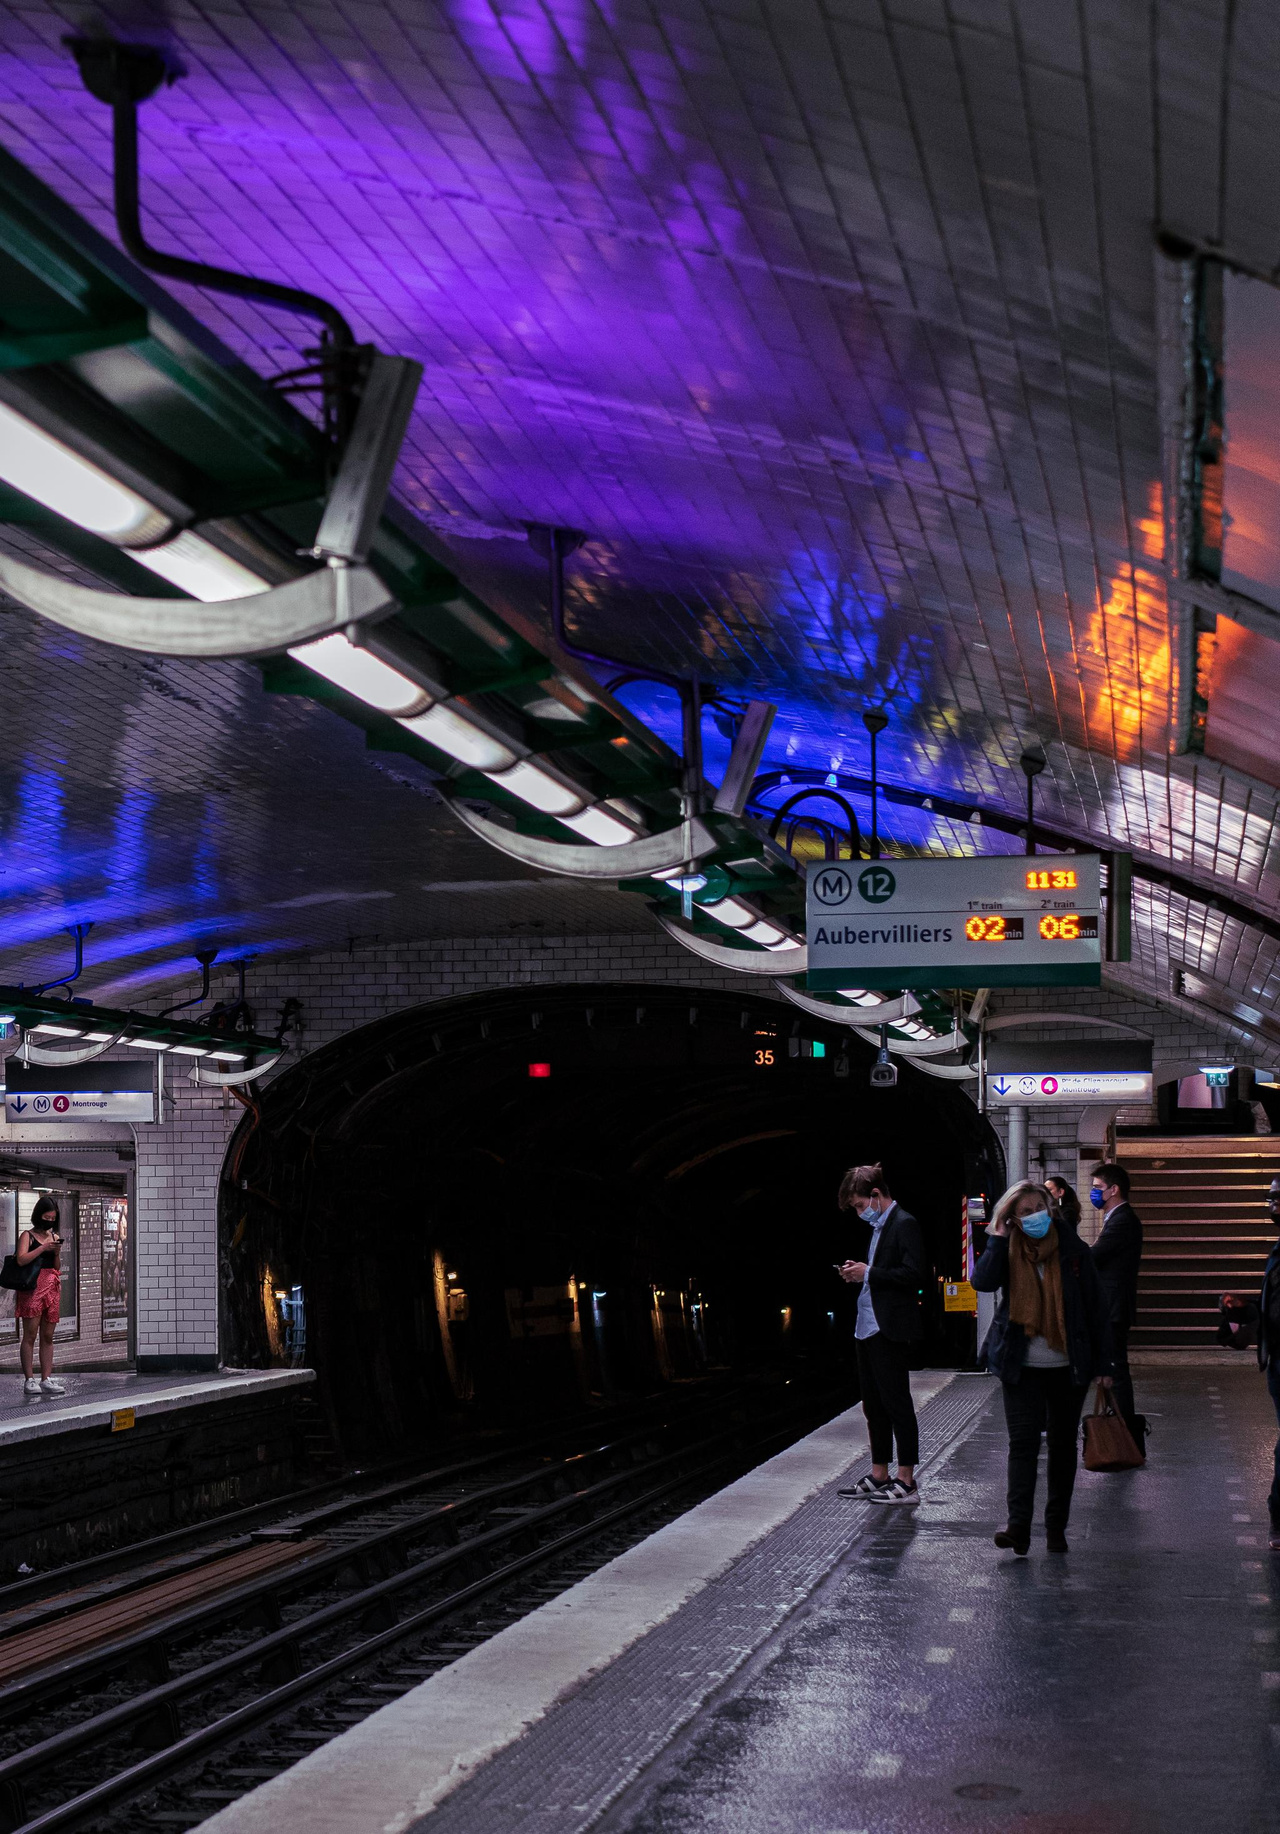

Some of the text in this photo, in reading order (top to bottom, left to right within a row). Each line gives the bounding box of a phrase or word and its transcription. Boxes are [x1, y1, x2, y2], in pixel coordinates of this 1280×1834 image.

[823, 874, 891, 897] M 12
[981, 902, 1003, 910] train
[1053, 900, 1075, 908] train
[814, 924, 952, 945] Aubervilliers
[966, 916, 1006, 941] 02
[1039, 915, 1079, 940] 06
[754, 1049, 775, 1065] 35
[56, 1098, 65, 1109] 4
